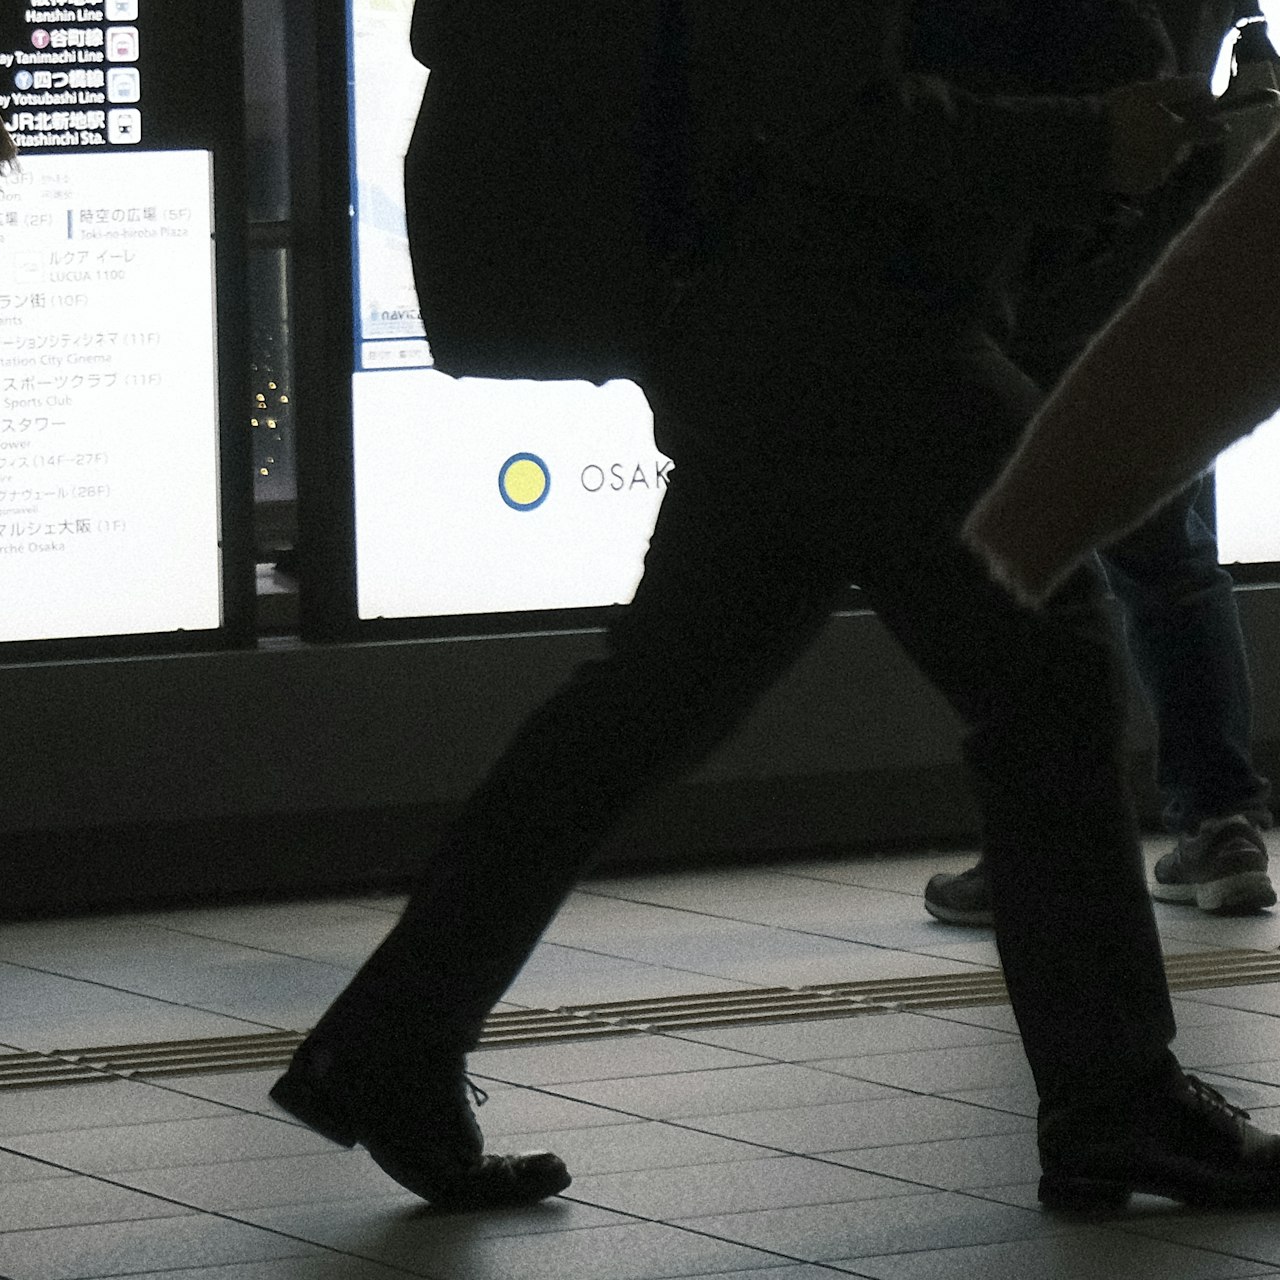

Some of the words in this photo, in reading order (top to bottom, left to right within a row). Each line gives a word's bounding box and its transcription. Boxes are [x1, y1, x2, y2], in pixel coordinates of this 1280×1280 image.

[25, 9, 75, 23] Hanshin
[77, 8, 103, 22] Line
[14, 49, 76, 64] Tanimachi
[77, 50, 104, 63] Line
[11, 91, 77, 106] Yotsubashi
[78, 91, 105, 104] Line
[80, 131, 106, 145] Sta.
[79, 207, 158, 223] 時空の広場
[161, 227, 189, 238] Plaza
[49, 250, 89, 265] ルクア
[96, 250, 136, 264] イーレ
[49, 271, 91, 282] LUCUA
[40, 355, 63, 367] City
[66, 353, 112, 365] Cinema
[3, 397, 43, 410] Sports
[46, 396, 73, 407] Club
[27, 541, 65, 554] Osaka
